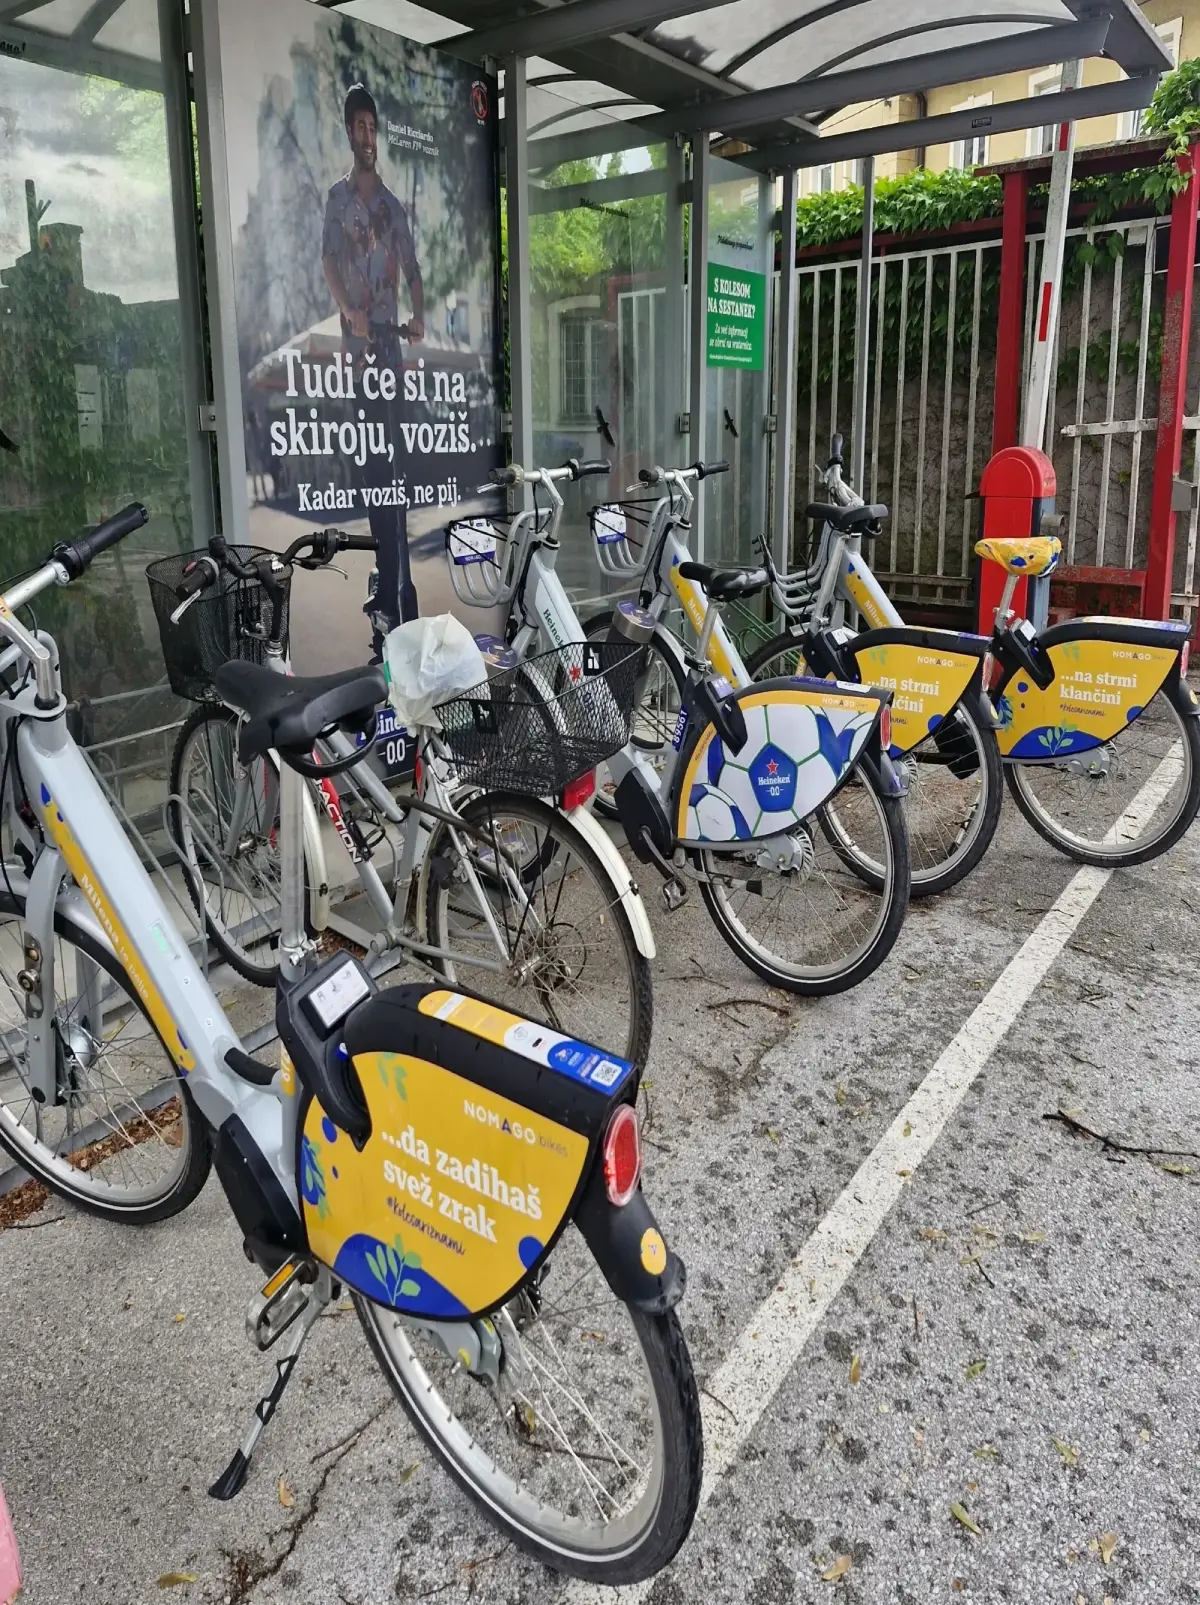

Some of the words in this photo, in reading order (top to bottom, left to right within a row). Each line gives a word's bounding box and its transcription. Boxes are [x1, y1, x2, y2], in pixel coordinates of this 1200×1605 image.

[387, 120, 406, 135] Daniel
[407, 126, 434, 143] Ricciardo
[387, 133, 412, 149] McLaren
[713, 277, 719, 293] S
[719, 278, 751, 299] KOLESOM
[707, 296, 718, 313] NA
[718, 299, 756, 319] SESTANEK?
[278, 348, 357, 399] Tudi
[362, 352, 397, 401] če
[403, 357, 428, 402] si
[432, 370, 467, 403] na
[270, 408, 395, 467] skiroju,
[297, 481, 357, 512] Kadar
[360, 479, 411, 509] voziš,
[413, 485, 434, 504] ne
[437, 476, 462, 508] pij.
[917, 656, 954, 667] NOMAGO
[1112, 650, 1151, 660] NOMAGO
[867, 676, 897, 690] ...na
[900, 678, 940, 696] strmi
[1061, 671, 1093, 683] ...na
[1096, 672, 1138, 688] strmi
[822, 697, 855, 706] NOMAGO
[1059, 683, 1121, 706] klančini
[673, 709, 688, 744] 89561
[757, 775, 791, 786] Heineken
[81, 872, 120, 946] Milena
[464, 1099, 536, 1146] NOMAGO
[538, 1132, 569, 1158] bikes
[381, 1124, 431, 1166] ...da
[435, 1148, 543, 1220] zadihaš
[383, 1159, 434, 1208] svež
[437, 1191, 498, 1243] zrak
